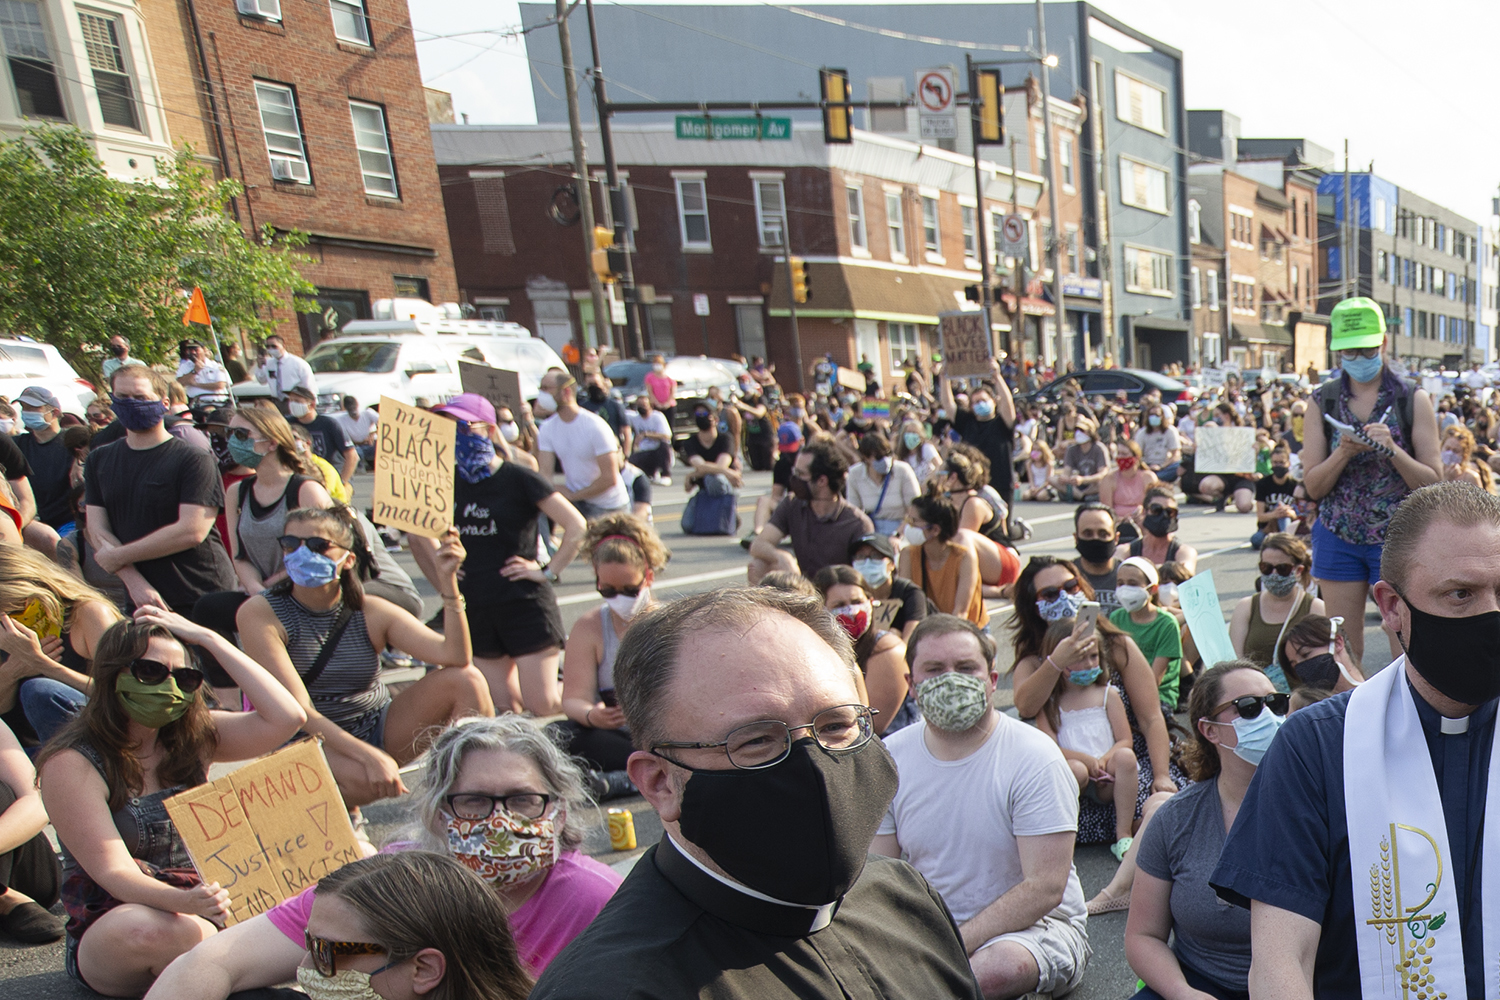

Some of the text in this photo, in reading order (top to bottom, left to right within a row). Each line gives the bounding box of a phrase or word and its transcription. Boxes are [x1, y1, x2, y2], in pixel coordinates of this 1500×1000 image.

[768, 121, 786, 137] Av
[942, 317, 983, 337] BLACK
[946, 334, 987, 350] LIVES
[946, 348, 990, 363] MATTER
[395, 408, 436, 440] my
[381, 423, 450, 474] BLACK
[379, 455, 454, 491] students
[390, 473, 447, 513] LIVES
[188, 761, 323, 842] DEMAND
[205, 833, 308, 889] Justice
[229, 846, 359, 923] END RACISM
